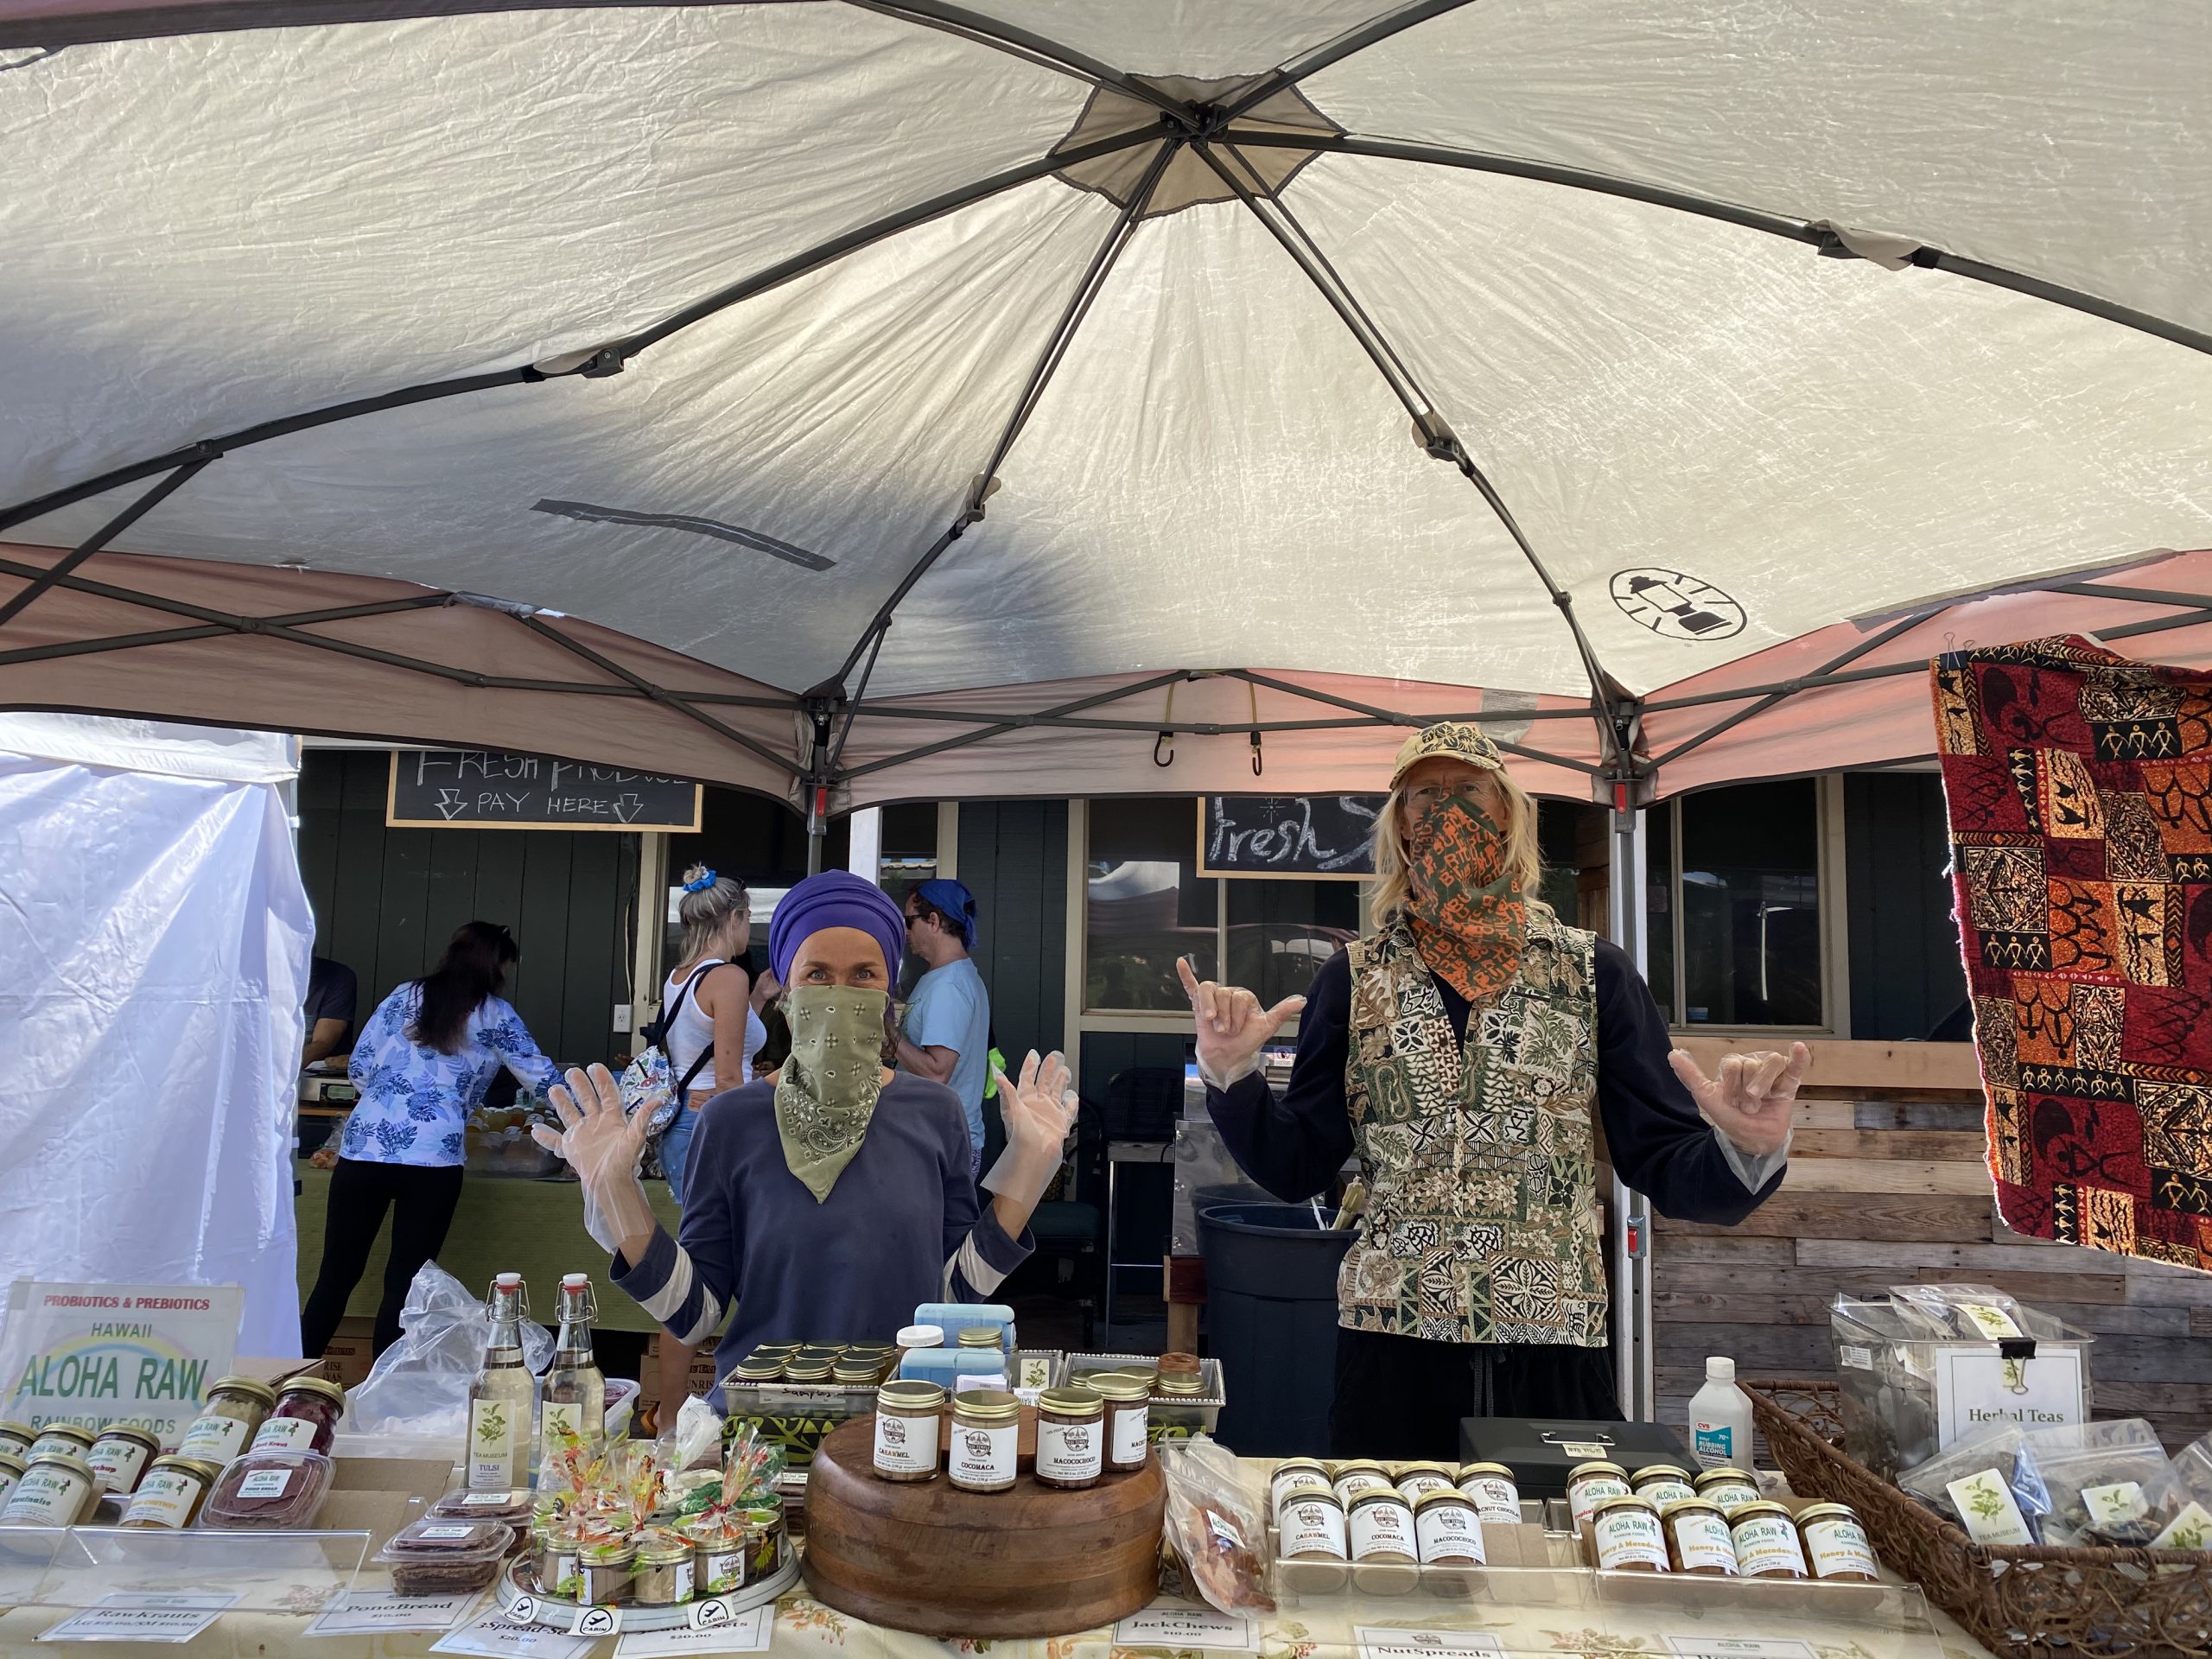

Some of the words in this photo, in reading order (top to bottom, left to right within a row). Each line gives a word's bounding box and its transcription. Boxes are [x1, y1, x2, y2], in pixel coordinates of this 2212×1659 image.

[476, 791, 531, 814] PAY
[547, 797, 610, 815] HERE
[43, 1294, 119, 1309] PROBIOTICS
[122, 1297, 133, 1309] &
[135, 1297, 210, 1311] PREBIOTICS
[90, 1322, 153, 1338] HAWAII
[16, 1354, 118, 1399] ALOHA
[134, 1357, 209, 1401] RAW
[2027, 1408, 2064, 1422] Teas
[1699, 1440, 1726, 1450] RUBBING
[878, 1446, 911, 1459] CARAWMEL
[1699, 1446, 1727, 1456] ALCOHOL
[960, 1461, 995, 1471] COCOMACA
[1585, 1486, 1605, 1497] ALOHA
[1607, 1486, 1621, 1496] RAW
[1656, 1491, 1677, 1501] ALOHA
[1717, 1493, 1738, 1503] ALOHA
[1741, 1493, 1754, 1503] RAW
[1609, 1520, 1630, 1534] ALOHA
[1632, 1520, 1648, 1531] RAW
[1705, 1524, 1724, 1535] ALOHA
[1992, 1528, 2021, 1537] MUSEUM
[1738, 1529, 1759, 1543] ALOHA
[1760, 1527, 1777, 1537] RAW
[1834, 1529, 1857, 1539] ALOHA
[1820, 1550, 1846, 1560] Honey
[346, 1601, 454, 1613] PonoBread
[702, 1615, 726, 1625] CABIN
[1131, 1621, 1233, 1631] JackChews
[1377, 1646, 1492, 1658] NutSpreads
